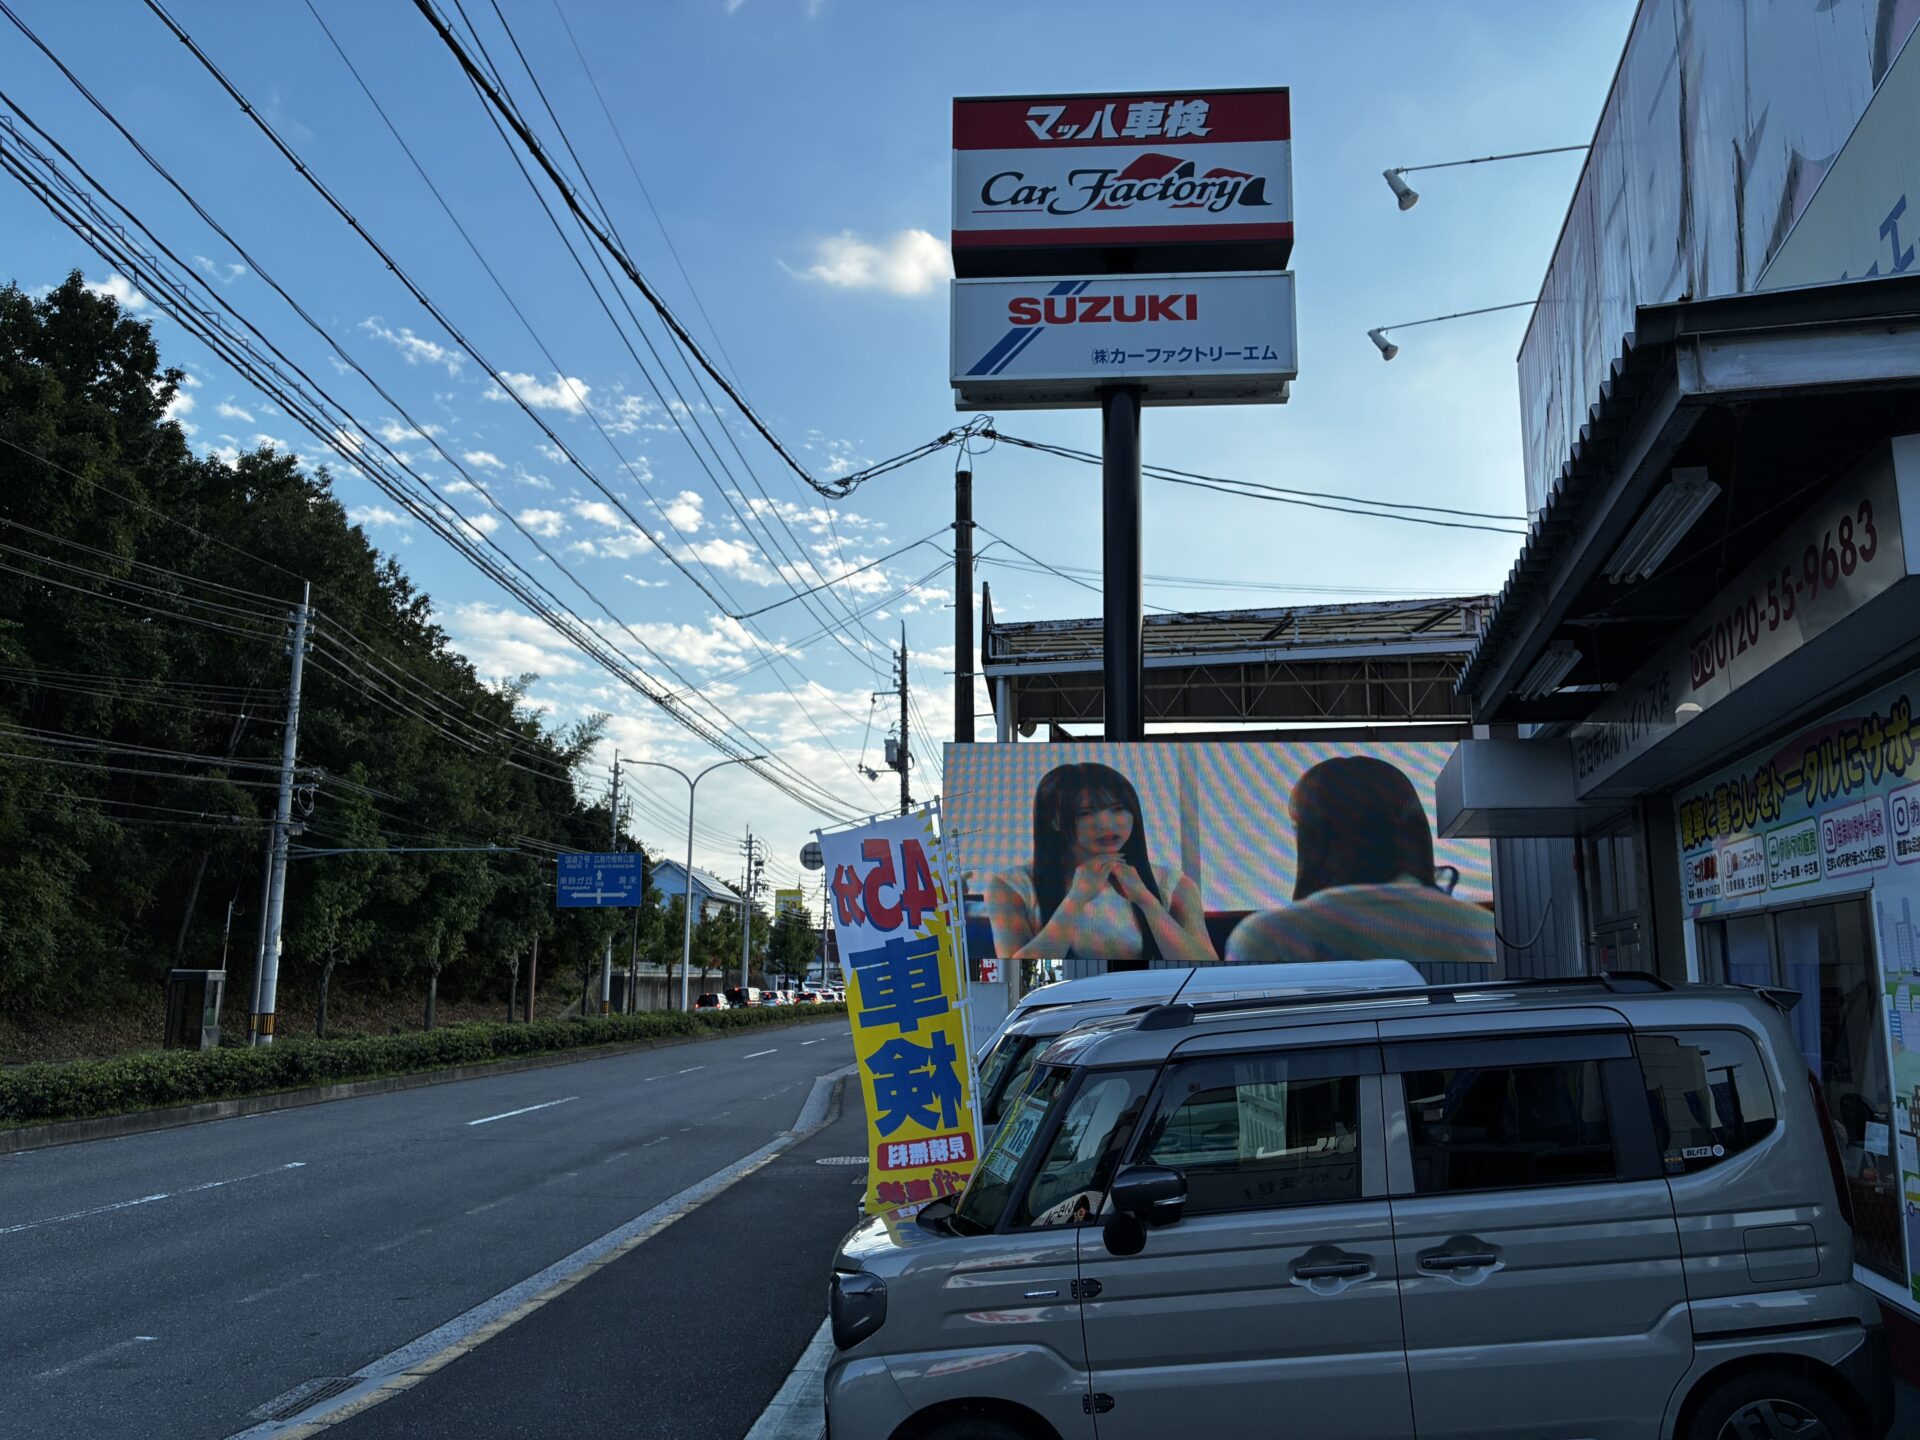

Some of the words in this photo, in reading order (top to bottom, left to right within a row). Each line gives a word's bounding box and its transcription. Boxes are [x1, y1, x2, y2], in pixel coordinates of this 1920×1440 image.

[1025, 98, 1213, 141] マッハ車検
[981, 171, 1056, 206] Car
[1047, 167, 1239, 216] Factory
[1008, 293, 1198, 325] SUZUKI
[1714, 498, 1877, 670] 0120-55-9683
[1686, 1148, 1708, 1157] BLITZ
